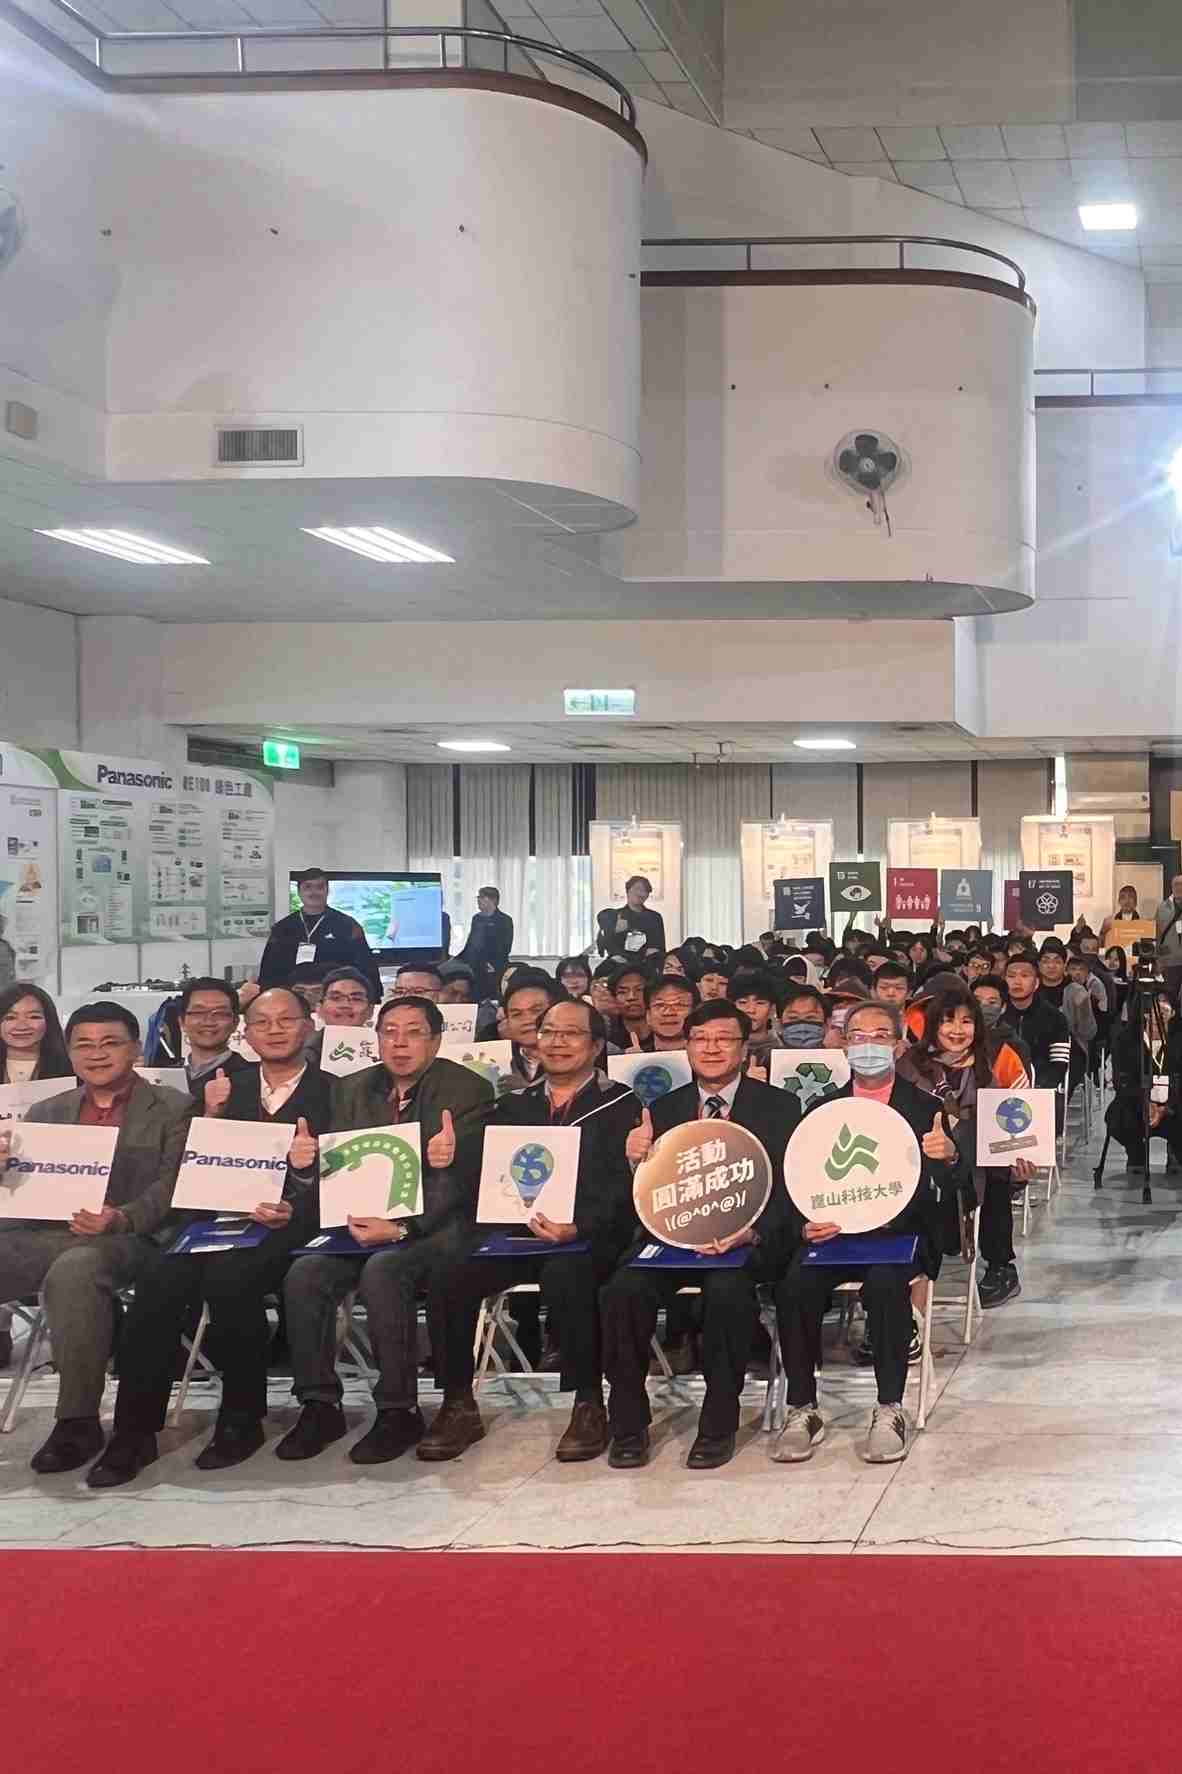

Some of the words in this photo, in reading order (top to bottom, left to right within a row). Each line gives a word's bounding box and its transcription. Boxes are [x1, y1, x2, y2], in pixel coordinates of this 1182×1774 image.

[97, 764, 173, 789] Panasonic
[6, 1156, 110, 1176] Panasonic
[183, 1150, 288, 1170] Panasonic
[676, 1138, 727, 1174] 活動
[652, 1158, 755, 1214] 圓滿成功
